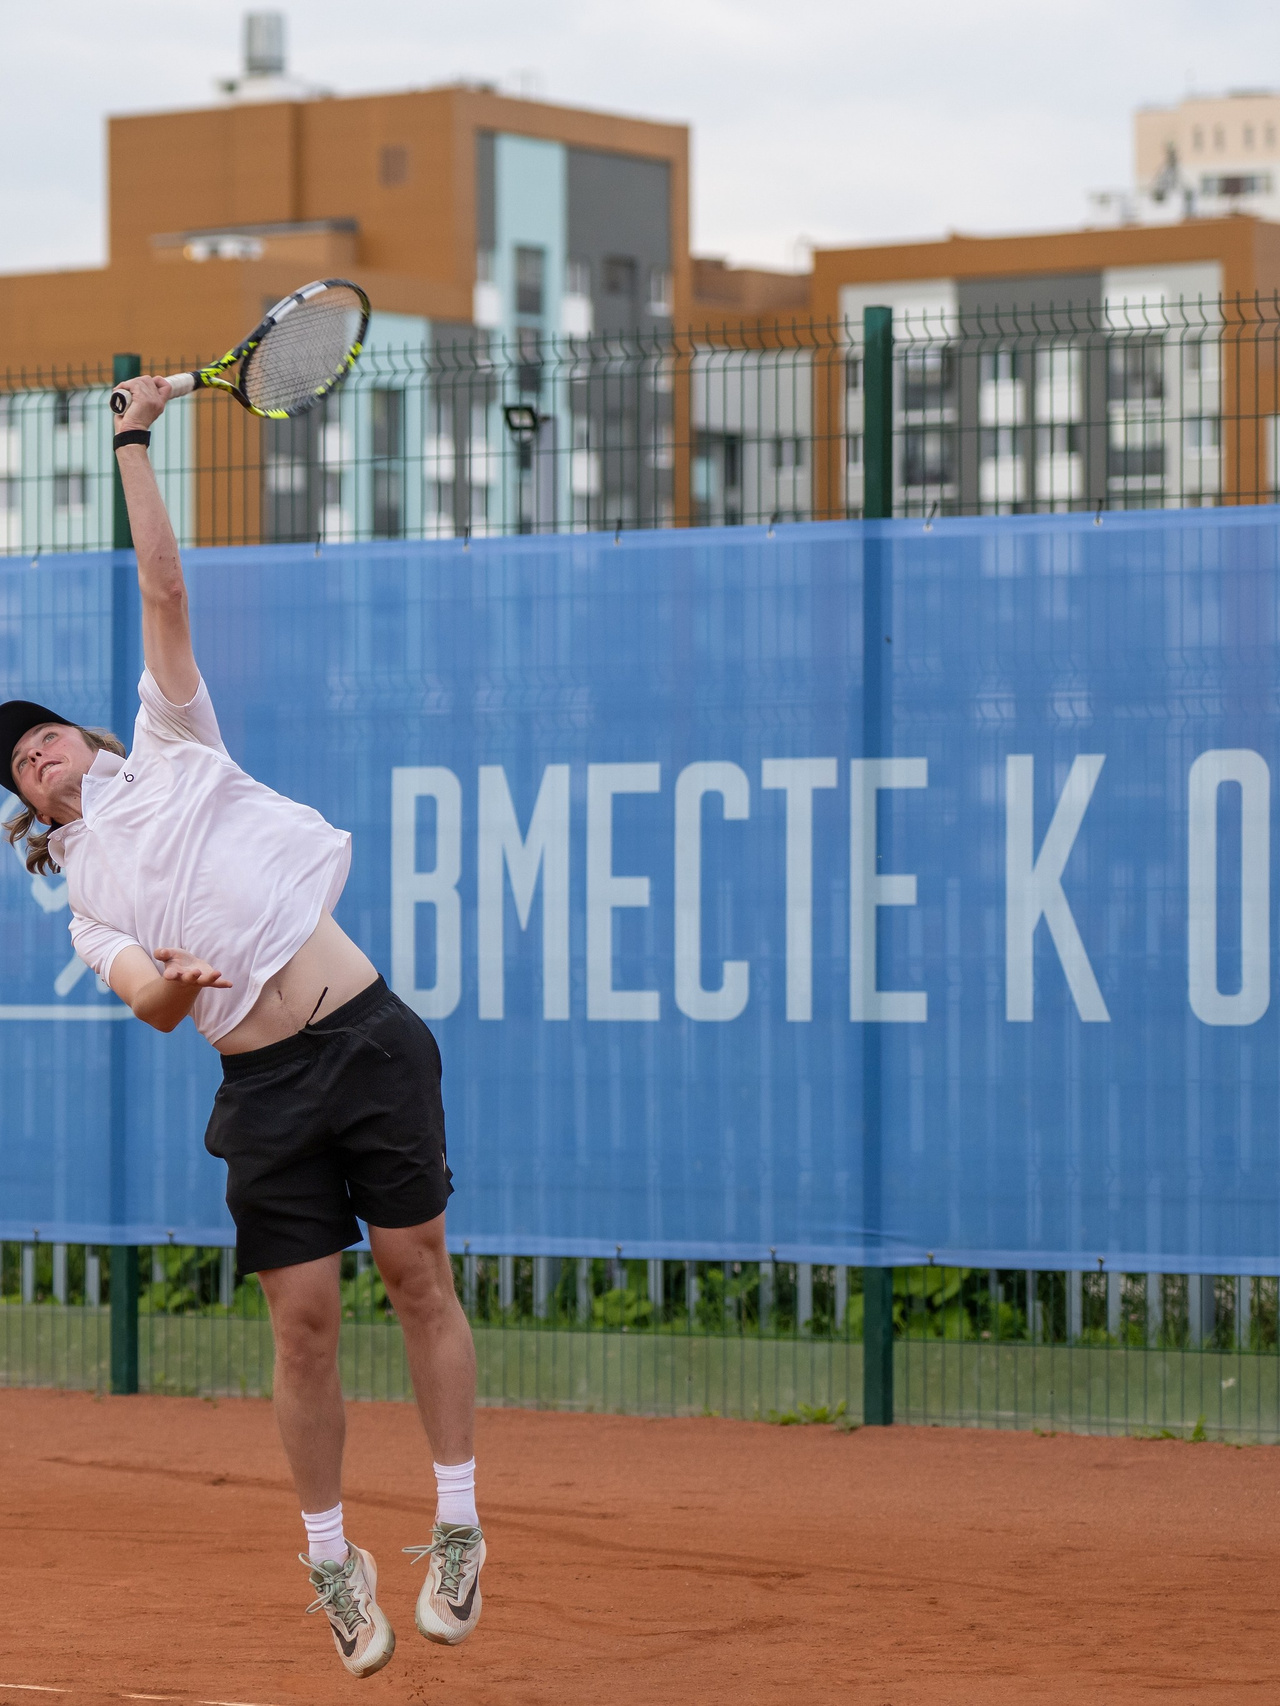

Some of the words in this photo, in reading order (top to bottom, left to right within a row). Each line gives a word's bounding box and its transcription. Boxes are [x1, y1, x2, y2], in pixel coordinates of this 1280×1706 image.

[391, 757, 928, 1022] ВМЕСТЕ
[1006, 754, 1111, 1022] К
[1188, 748, 1271, 1026] О
